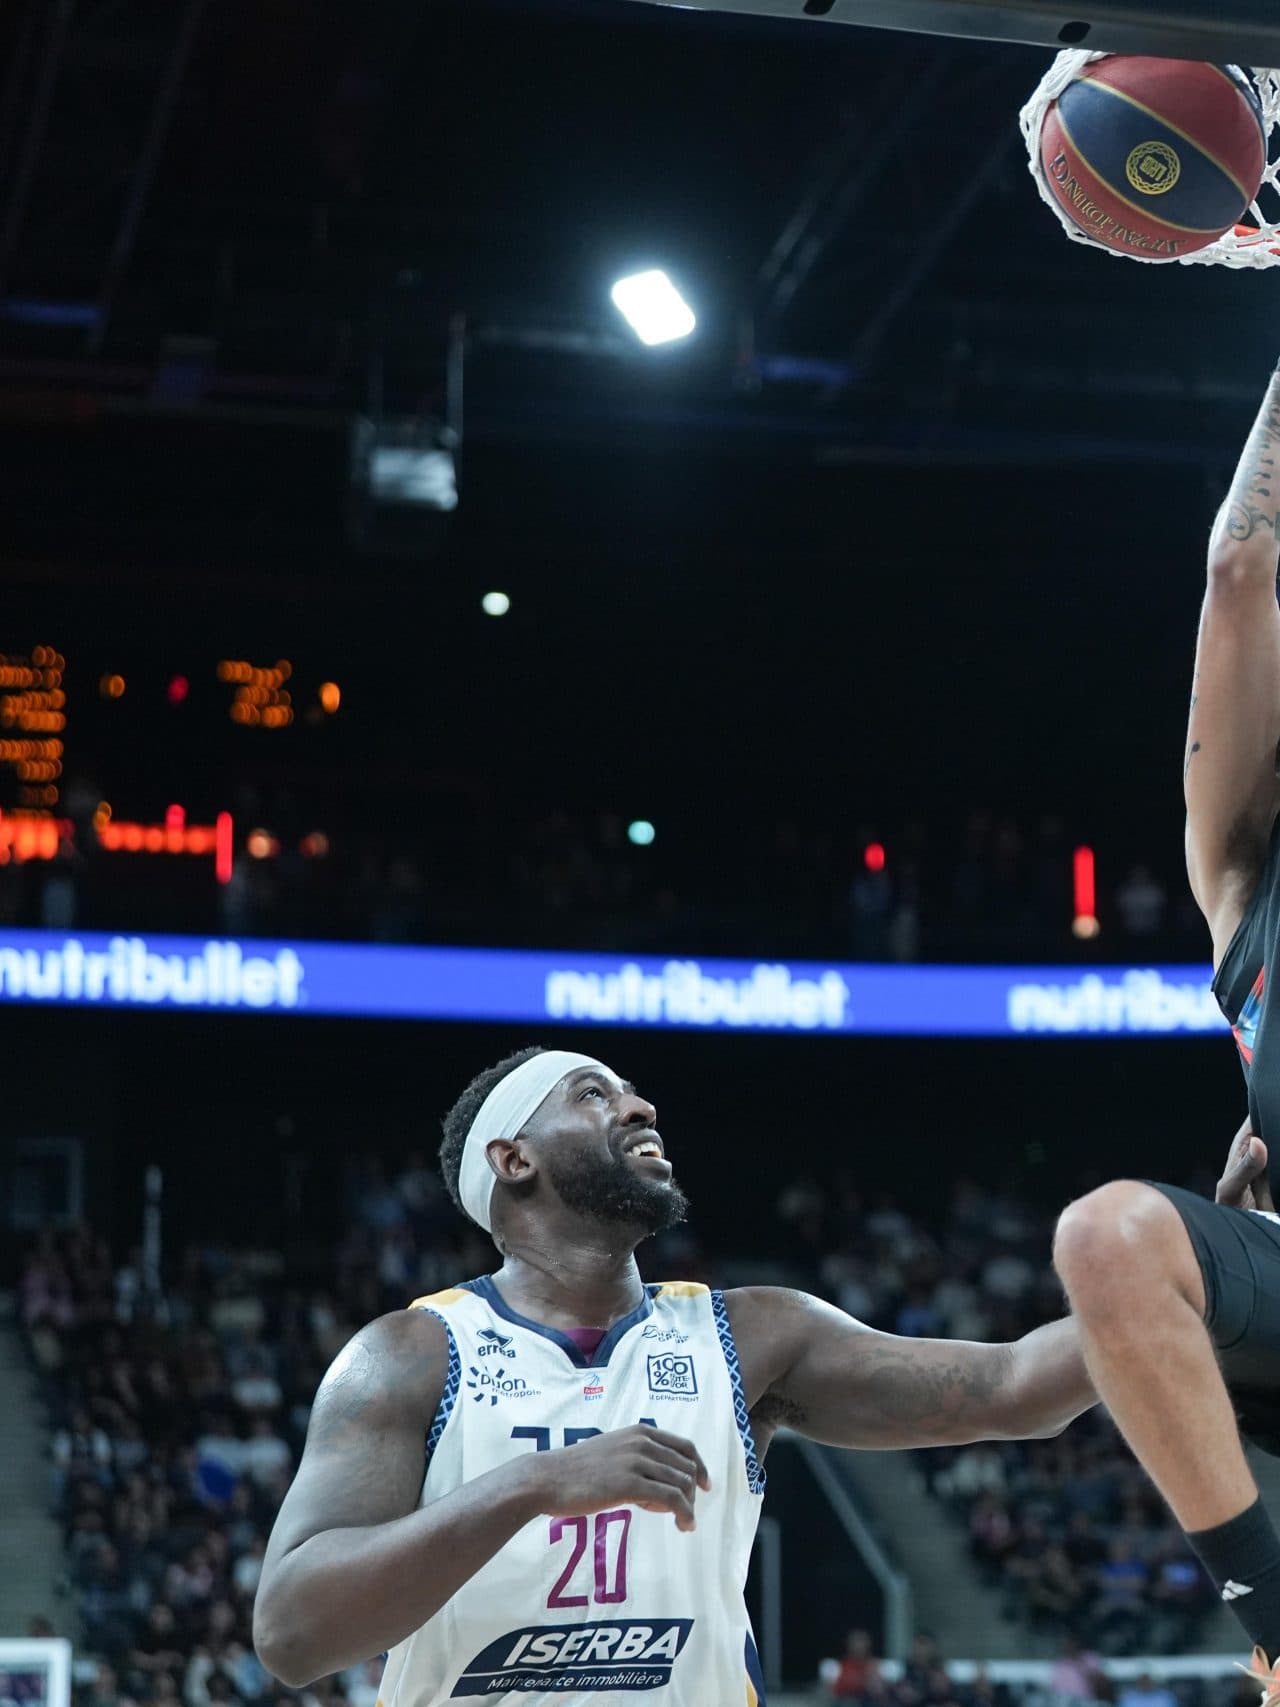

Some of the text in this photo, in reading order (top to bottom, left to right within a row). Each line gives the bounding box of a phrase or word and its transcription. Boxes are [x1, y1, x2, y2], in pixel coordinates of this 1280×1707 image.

[545, 960, 849, 1029] nutribullet
[1008, 969, 1233, 1032] nutribu
[547, 1509, 632, 1609] 20
[502, 1626, 681, 1668] ISERBA
[576, 1670, 663, 1687] immobilière
